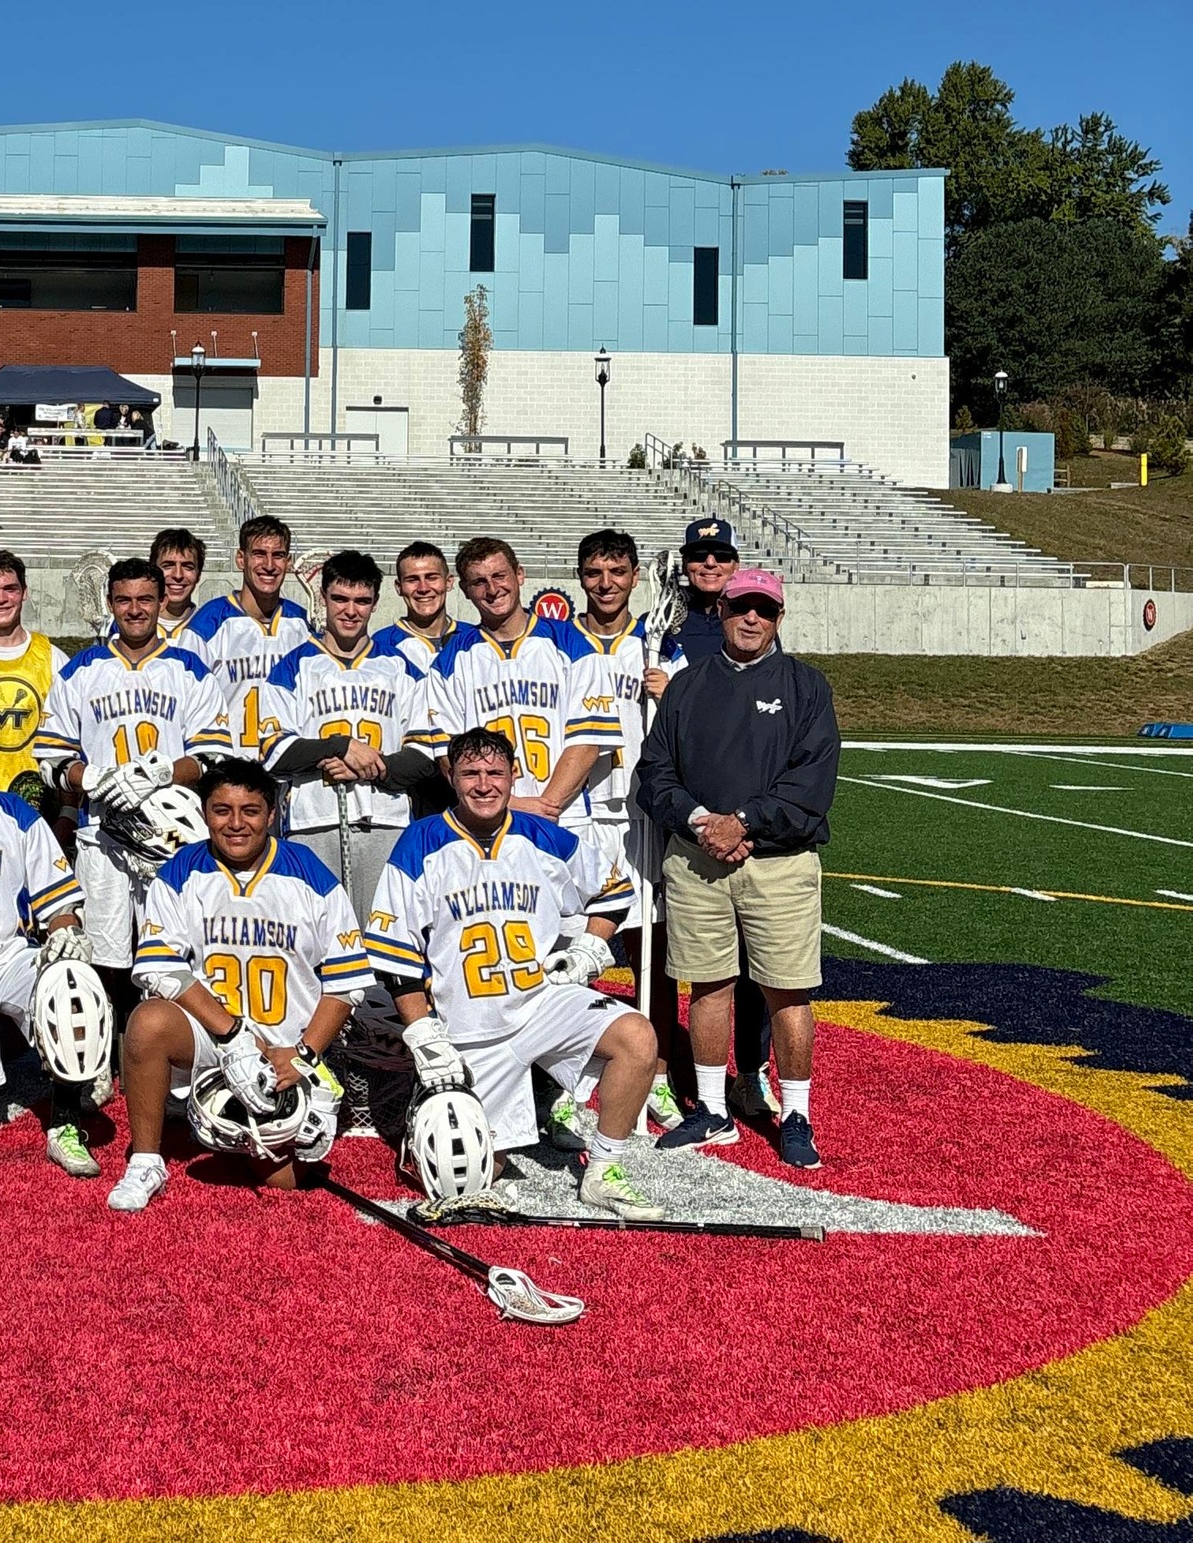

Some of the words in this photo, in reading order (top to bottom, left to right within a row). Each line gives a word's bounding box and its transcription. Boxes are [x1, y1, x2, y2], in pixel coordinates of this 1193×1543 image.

[540, 602, 564, 620] W
[582, 695, 615, 713] WT
[460, 920, 544, 998] 29
[204, 953, 288, 1026] 30
